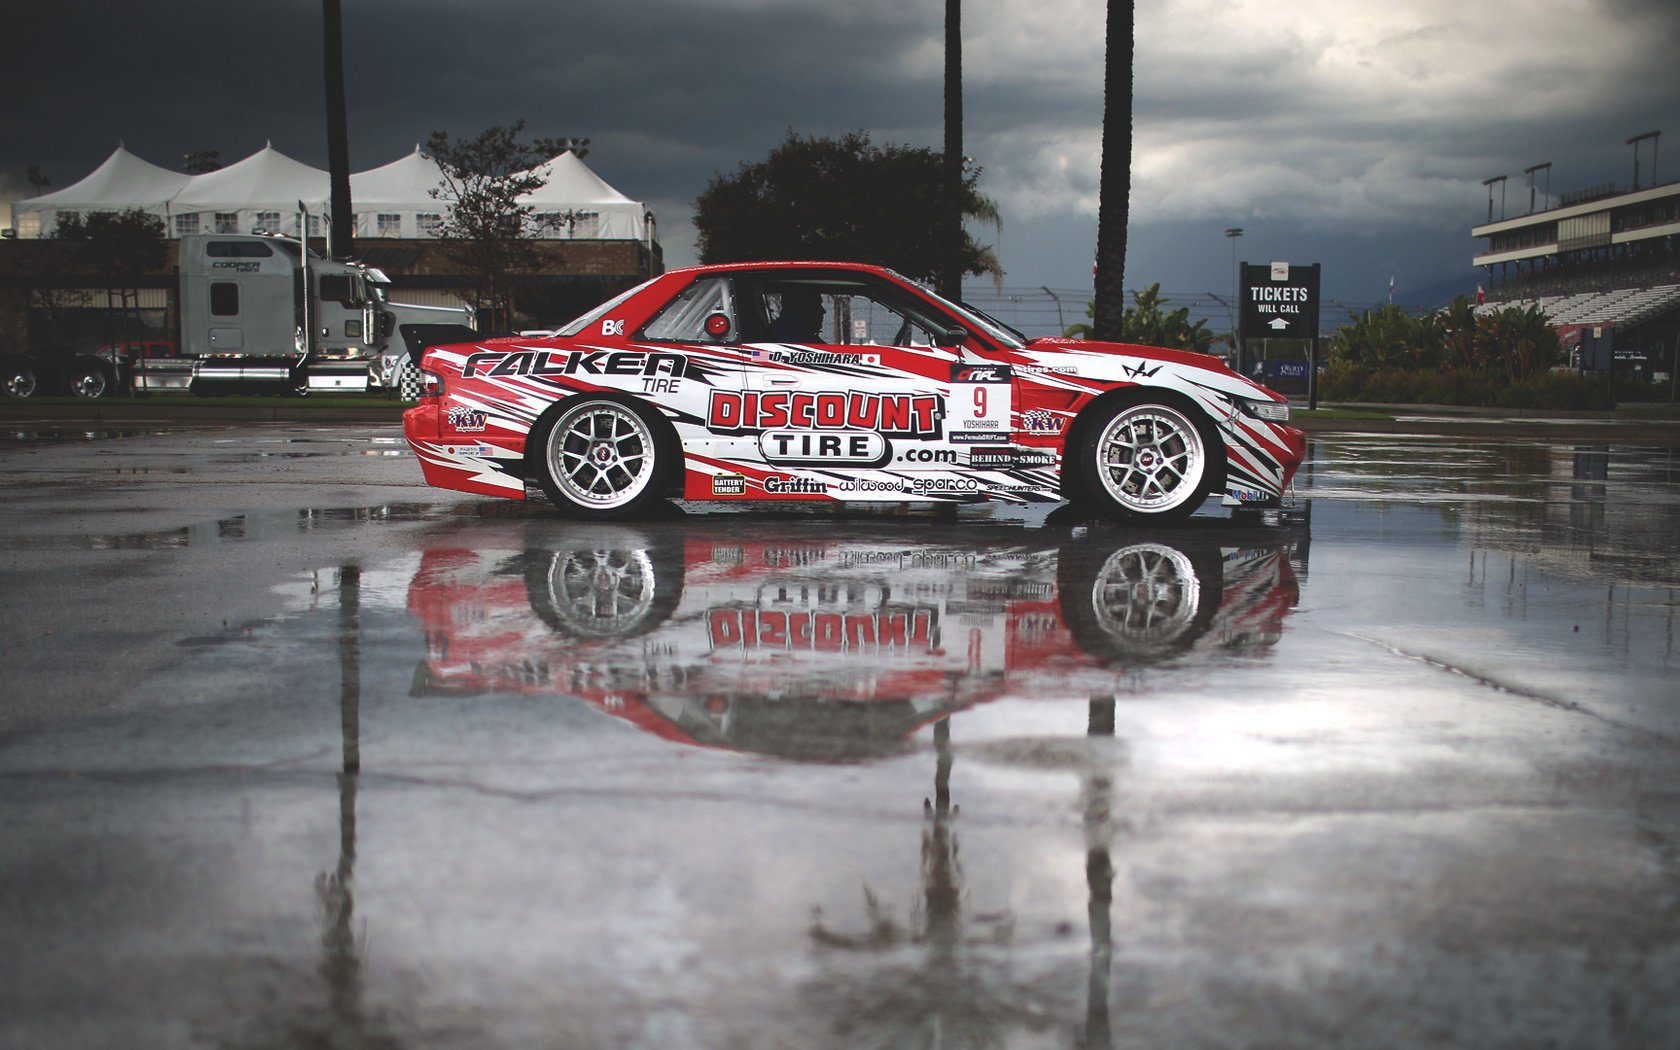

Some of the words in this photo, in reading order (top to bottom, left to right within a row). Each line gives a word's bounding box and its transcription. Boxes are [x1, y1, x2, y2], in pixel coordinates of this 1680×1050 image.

[1250, 287, 1308, 302] TICKETS
[1258, 304, 1277, 313] WILL
[1280, 304, 1300, 313] CALL
[461, 351, 688, 378] FALKEN
[789, 352, 861, 365] YOSHIHARA
[642, 378, 681, 394] TIRE
[974, 386, 988, 418] 9
[709, 389, 942, 436] DISCOUNT
[455, 413, 488, 428] KW
[963, 420, 999, 429] YOSHIHARA
[1031, 417, 1066, 431] KW
[772, 435, 869, 457] TIRE
[895, 448, 958, 464] .com
[971, 455, 1011, 463] BEHIND
[1019, 455, 1056, 465] SMOKE
[765, 477, 828, 494] Griffin
[839, 478, 905, 492] wilwood
[913, 479, 978, 494] sparco
[1232, 489, 1258, 501] Mobil
